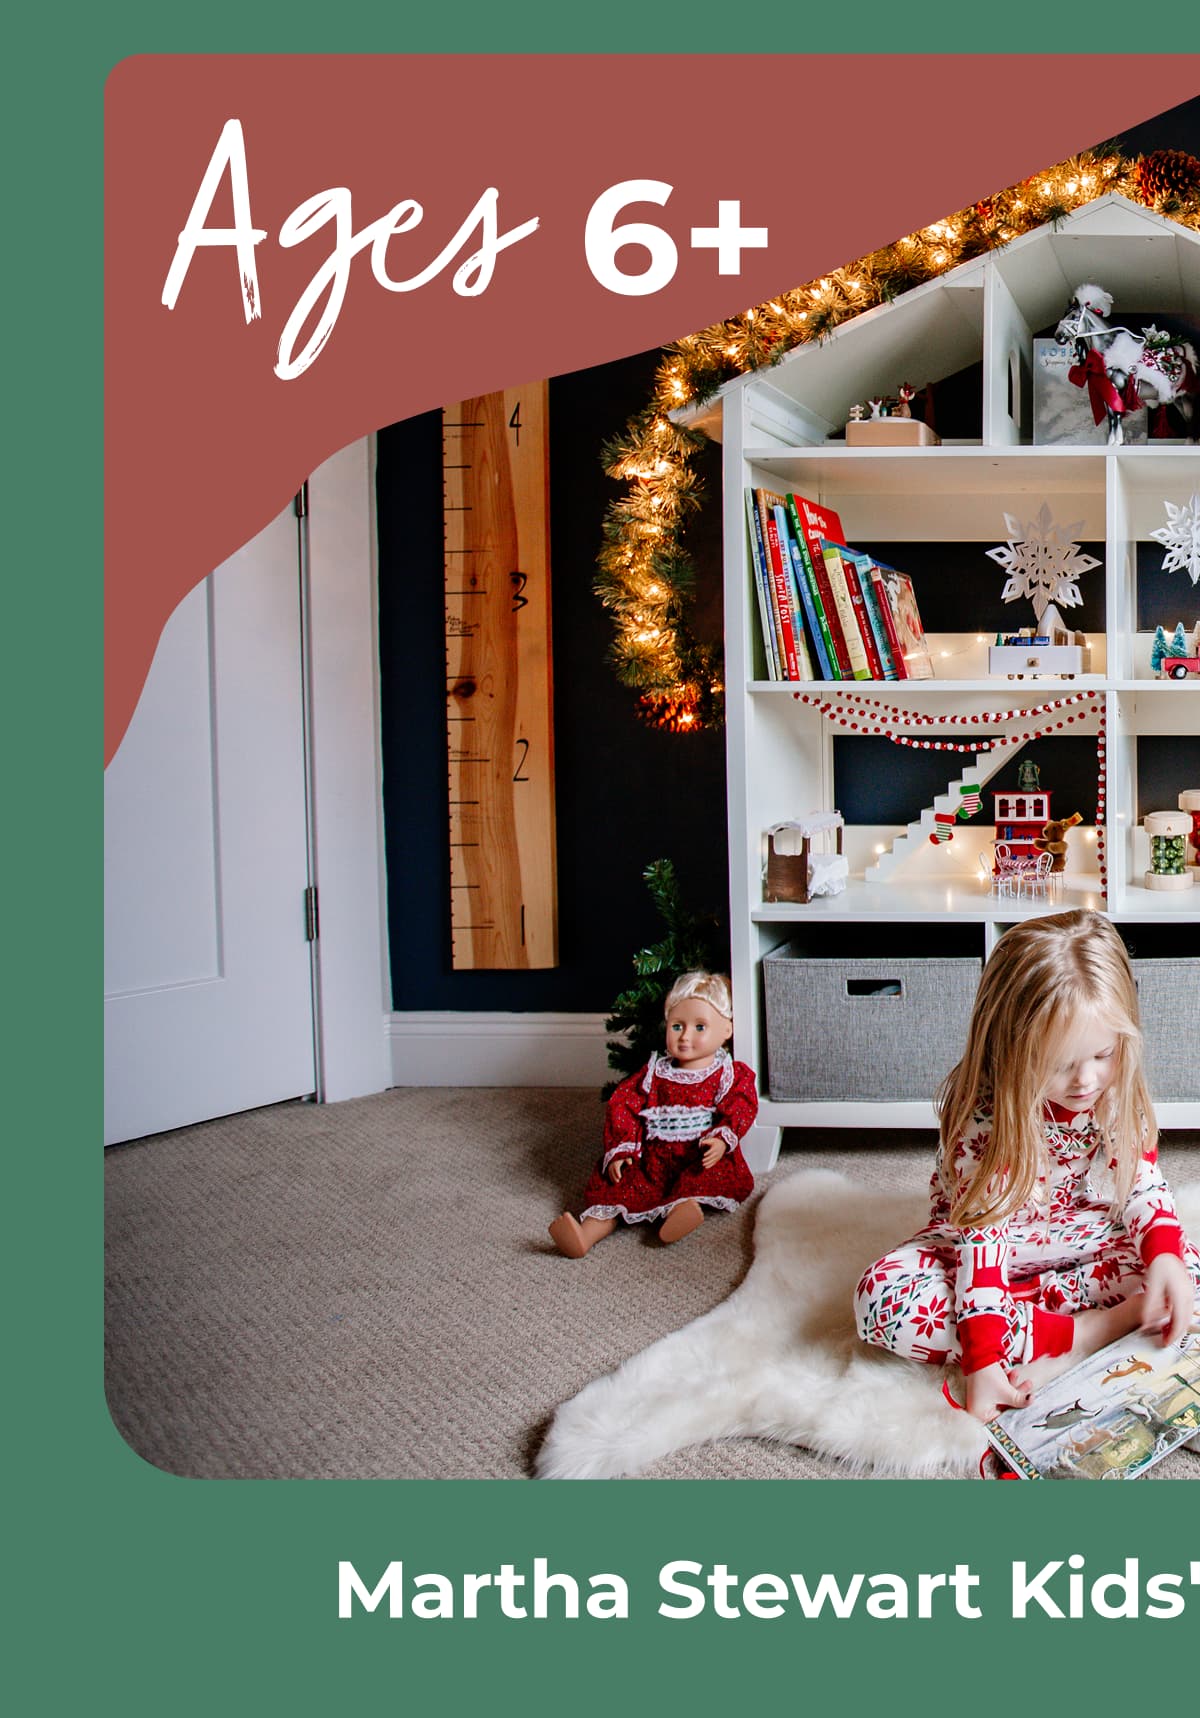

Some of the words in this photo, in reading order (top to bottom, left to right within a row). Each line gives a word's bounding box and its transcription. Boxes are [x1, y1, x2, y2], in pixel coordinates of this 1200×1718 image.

[509, 402, 522, 447] 4
[509, 571, 528, 613] 3
[775, 573, 787, 601] SANTA
[780, 603, 790, 625] POST
[512, 739, 529, 782] 2
